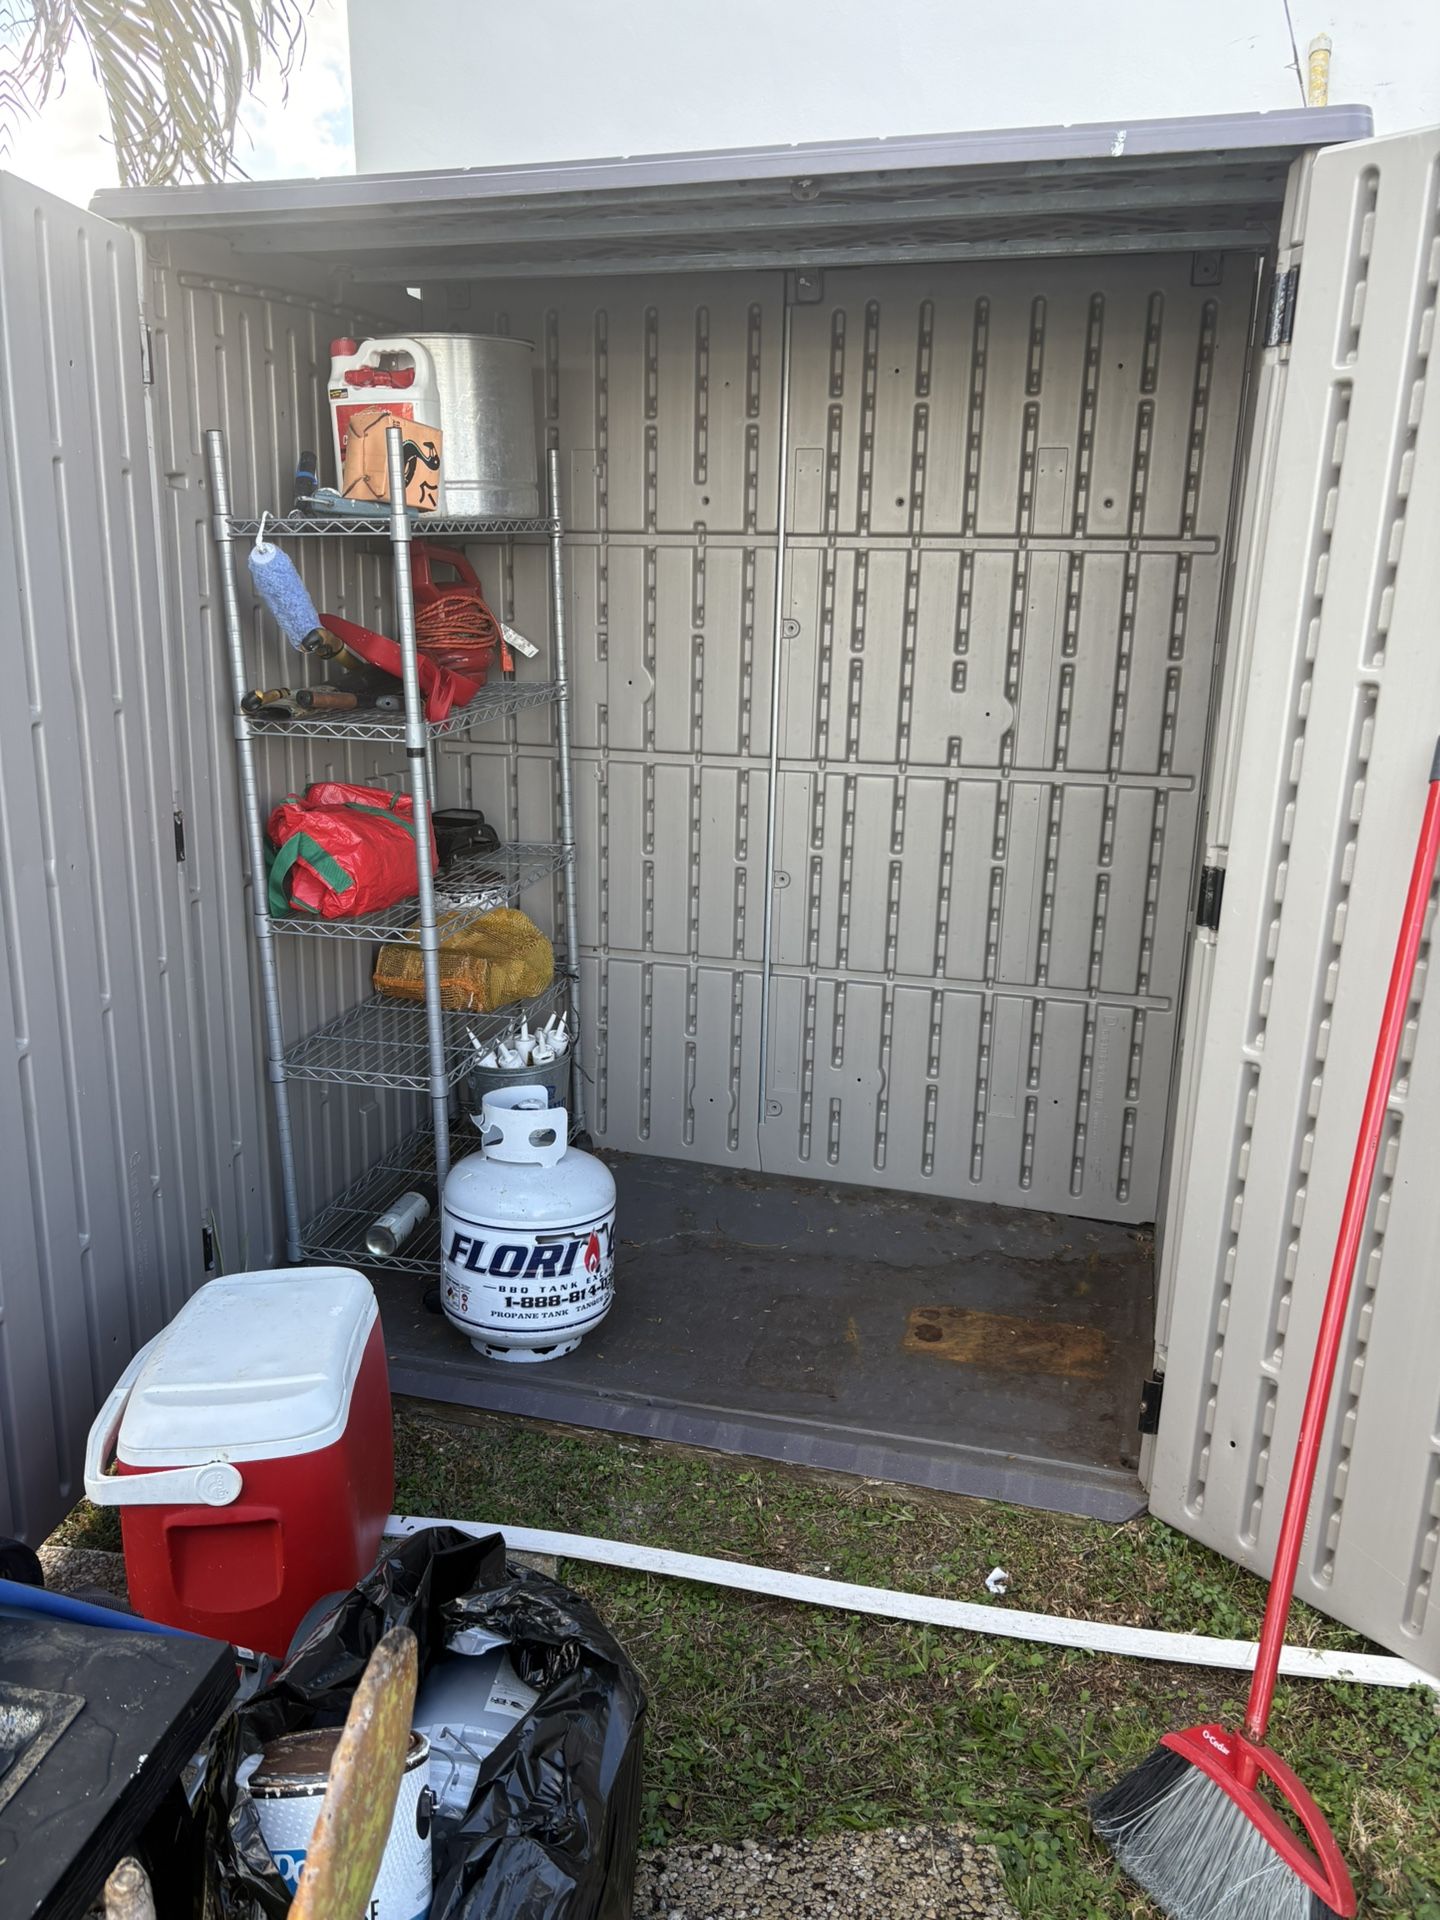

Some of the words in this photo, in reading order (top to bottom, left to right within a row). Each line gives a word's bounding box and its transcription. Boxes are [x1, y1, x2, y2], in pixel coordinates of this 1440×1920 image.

[540, 1281, 578, 1293] TANK
[490, 1310, 539, 1319] PROPANE
[542, 1309, 569, 1318] TANK
[1202, 1730, 1230, 1755] O-Cedar
